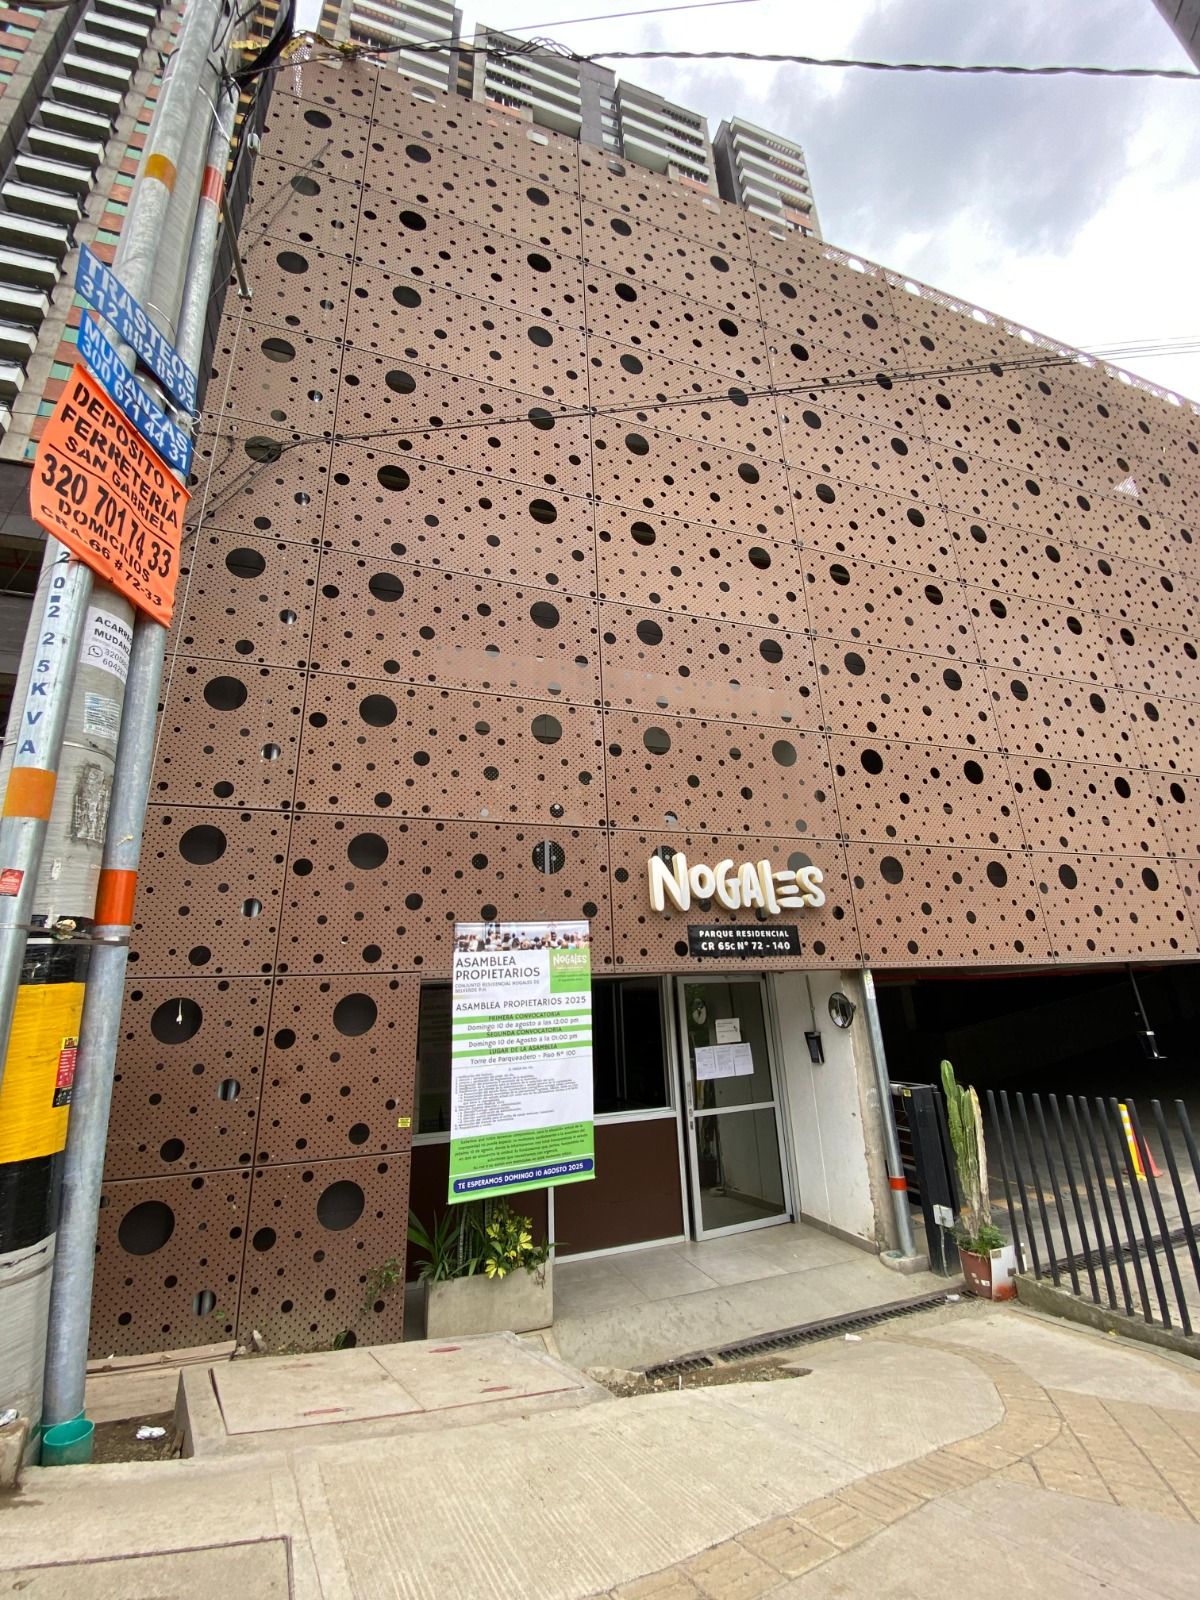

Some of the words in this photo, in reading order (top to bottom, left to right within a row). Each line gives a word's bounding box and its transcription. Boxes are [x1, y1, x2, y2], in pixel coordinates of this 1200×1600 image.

[85, 250, 195, 394] TRASTEOS
[81, 274, 118, 326] 312
[123, 319, 153, 366] 882
[156, 358, 175, 387] 85
[178, 385, 195, 411] 93
[85, 315, 187, 453] MUDANZAS
[82, 335, 110, 383] 300
[114, 381, 141, 421] 671
[144, 422, 164, 447] 44
[169, 442, 187, 469] 31
[73, 382, 164, 489] DEPOSITO
[171, 485, 181, 504] Y
[61, 404, 178, 529] FERRETERÍA
[65, 436, 107, 473] SAN
[112, 471, 167, 535] GABRIEL
[41, 454, 88, 506] 320
[94, 485, 127, 537] 701
[128, 520, 146, 560] 74
[148, 541, 171, 578] 33
[58, 499, 149, 582] DOMICILIOS
[114, 559, 123, 571] #
[125, 570, 162, 606] 72-33
[648, 852, 825, 914] NOGALES
[699, 930, 734, 938] PARQUE
[736, 930, 789, 938] RESIDENCIAL
[701, 942, 715, 951] CR
[751, 941, 763, 950] 72
[772, 941, 790, 950] 140
[456, 956, 517, 968] ASAMBLEA
[553, 953, 587, 966] NOGALES
[455, 967, 540, 980] PROPIETARIOS
[456, 1001, 500, 1011] ASAMBLEA
[503, 998, 562, 1008] PROPIETARIOS
[565, 996, 586, 1004] 2025
[515, 1011, 560, 1020] CONVOCATORIA
[468, 1023, 495, 1032] Domingo
[515, 1021, 536, 1029] agosto
[486, 1030, 515, 1038] SEGUNDA
[516, 1027, 562, 1036] CONVOCATORIA
[468, 1039, 496, 1049] Domingo
[516, 1036, 537, 1045] Agosto
[489, 1047, 509, 1055] LUGAR
[528, 1043, 558, 1051] ASAMBLEA
[498, 1053, 537, 1063] Parqueadero
[458, 1182, 466, 1190] TE
[467, 1176, 503, 1188] ESPERAMOS
[504, 1171, 534, 1182] DOMINGO
[535, 1169, 542, 1177] 10
[543, 1166, 567, 1176] AGOSTO
[568, 1162, 584, 1171] 2025
